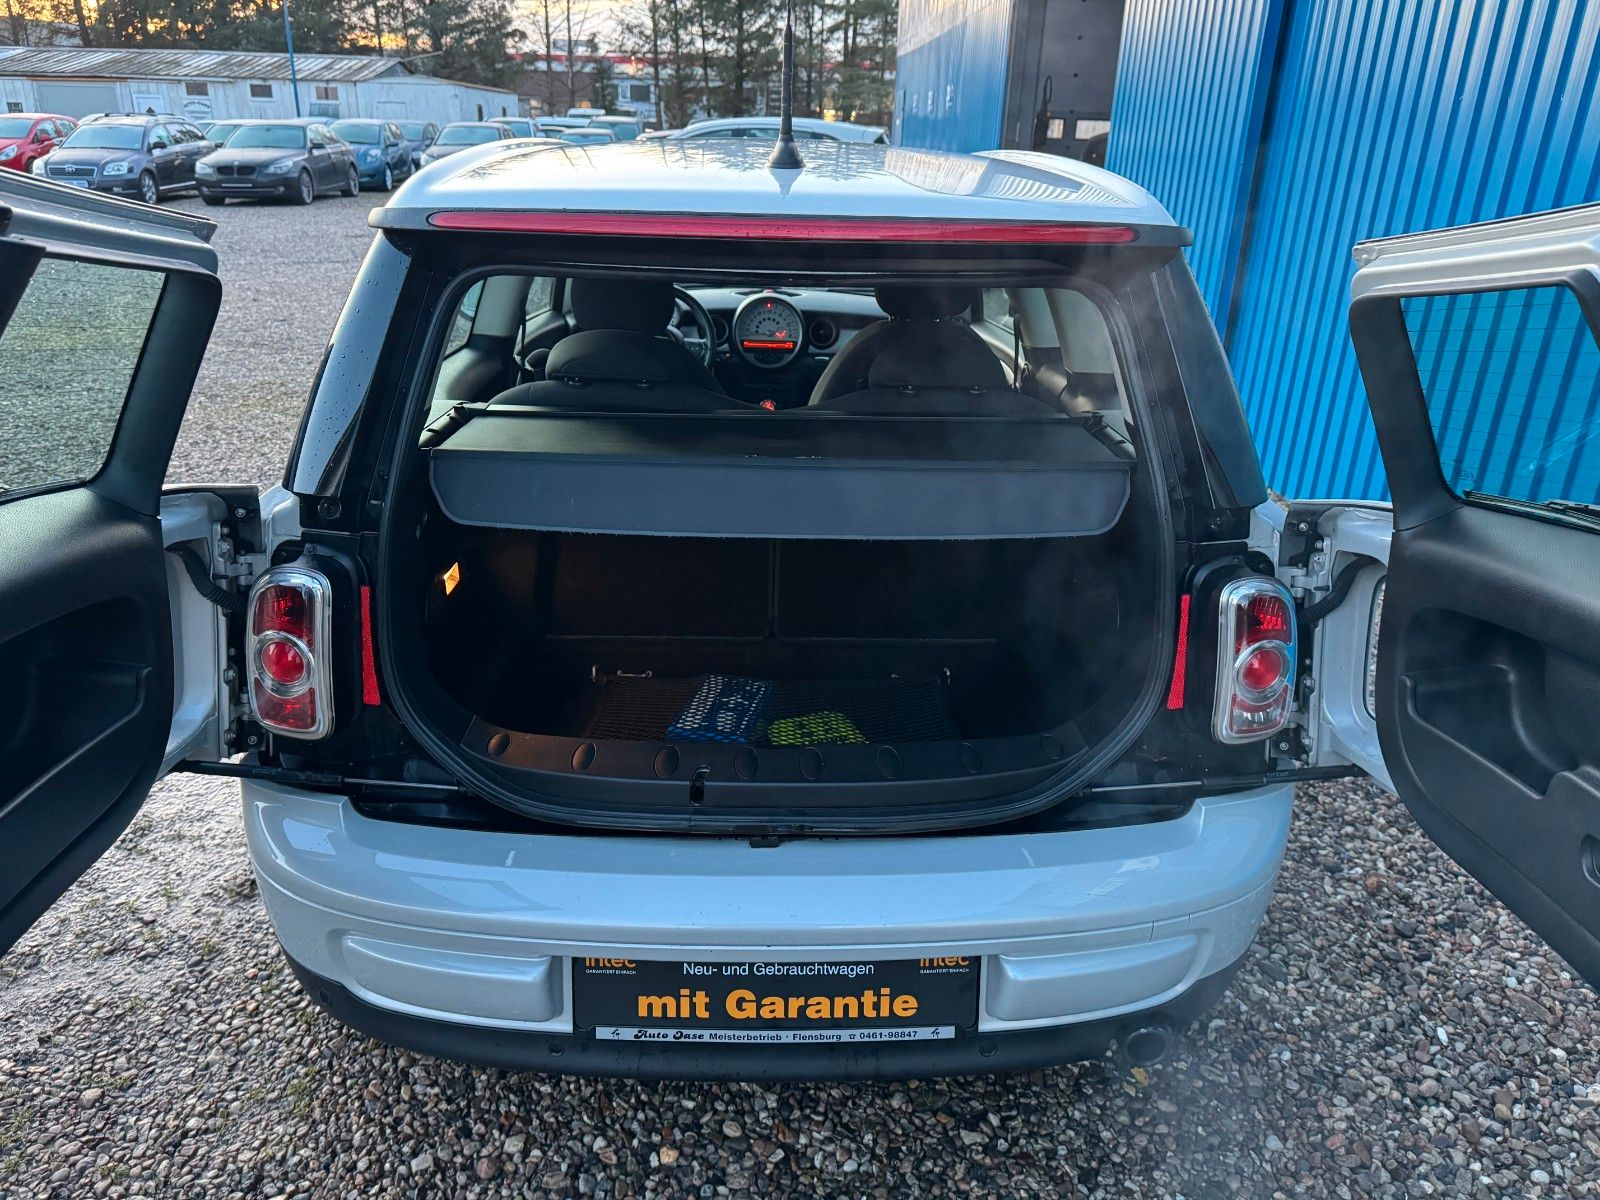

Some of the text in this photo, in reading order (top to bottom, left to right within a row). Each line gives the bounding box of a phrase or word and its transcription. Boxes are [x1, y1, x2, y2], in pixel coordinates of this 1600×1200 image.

[683, 962, 875, 978] Neu- und Gebrauchtwagen
[637, 987, 919, 1020] mit Garantie
[633, 1029, 669, 1040] Auto
[708, 1032, 782, 1041] Meisterbetrieb
[792, 1033, 842, 1042] Flensburg
[859, 1030, 918, 1040] 0461-98847
